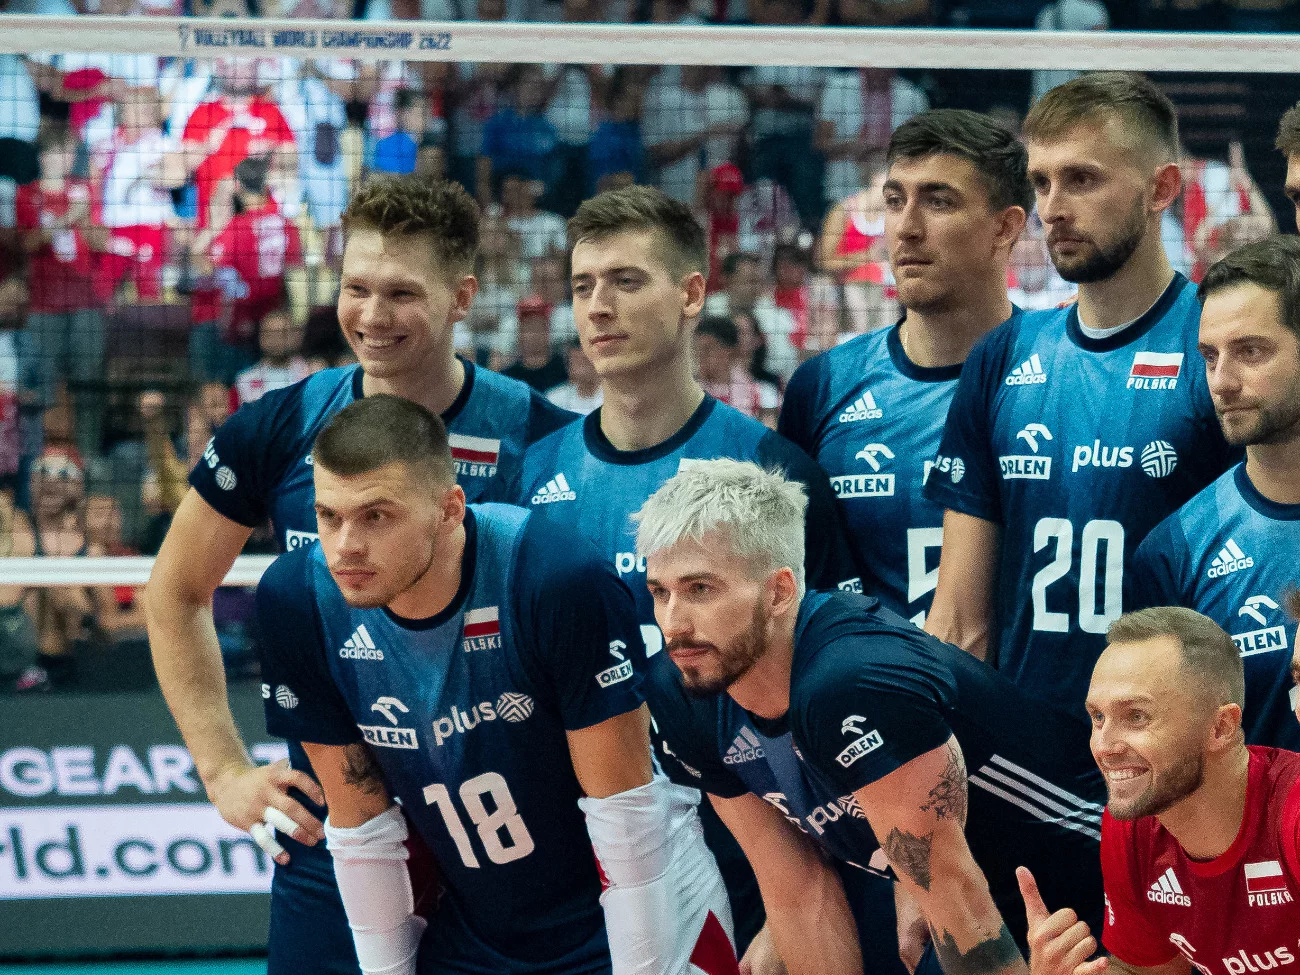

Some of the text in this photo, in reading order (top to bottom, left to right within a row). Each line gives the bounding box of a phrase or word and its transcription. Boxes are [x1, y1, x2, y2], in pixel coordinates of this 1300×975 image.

[419, 33, 452, 50] 2022
[1005, 373, 1047, 386] adidas
[1126, 378, 1178, 391] POLSKA
[839, 409, 883, 422] adidas
[1072, 439, 1135, 473] plus
[833, 478, 889, 494] ORLEN
[532, 490, 577, 505] adidas
[1031, 517, 1125, 634] 20
[1207, 557, 1255, 579] adidas
[1235, 630, 1282, 653] RLEN
[338, 648, 384, 661] adidas
[600, 664, 633, 685] ORLEN
[432, 702, 498, 747] plus
[723, 748, 766, 765] adida
[841, 733, 881, 764] ORLEN
[422, 771, 535, 868] 18
[1147, 890, 1191, 907] adidas
[1249, 890, 1294, 907] POLSKA
